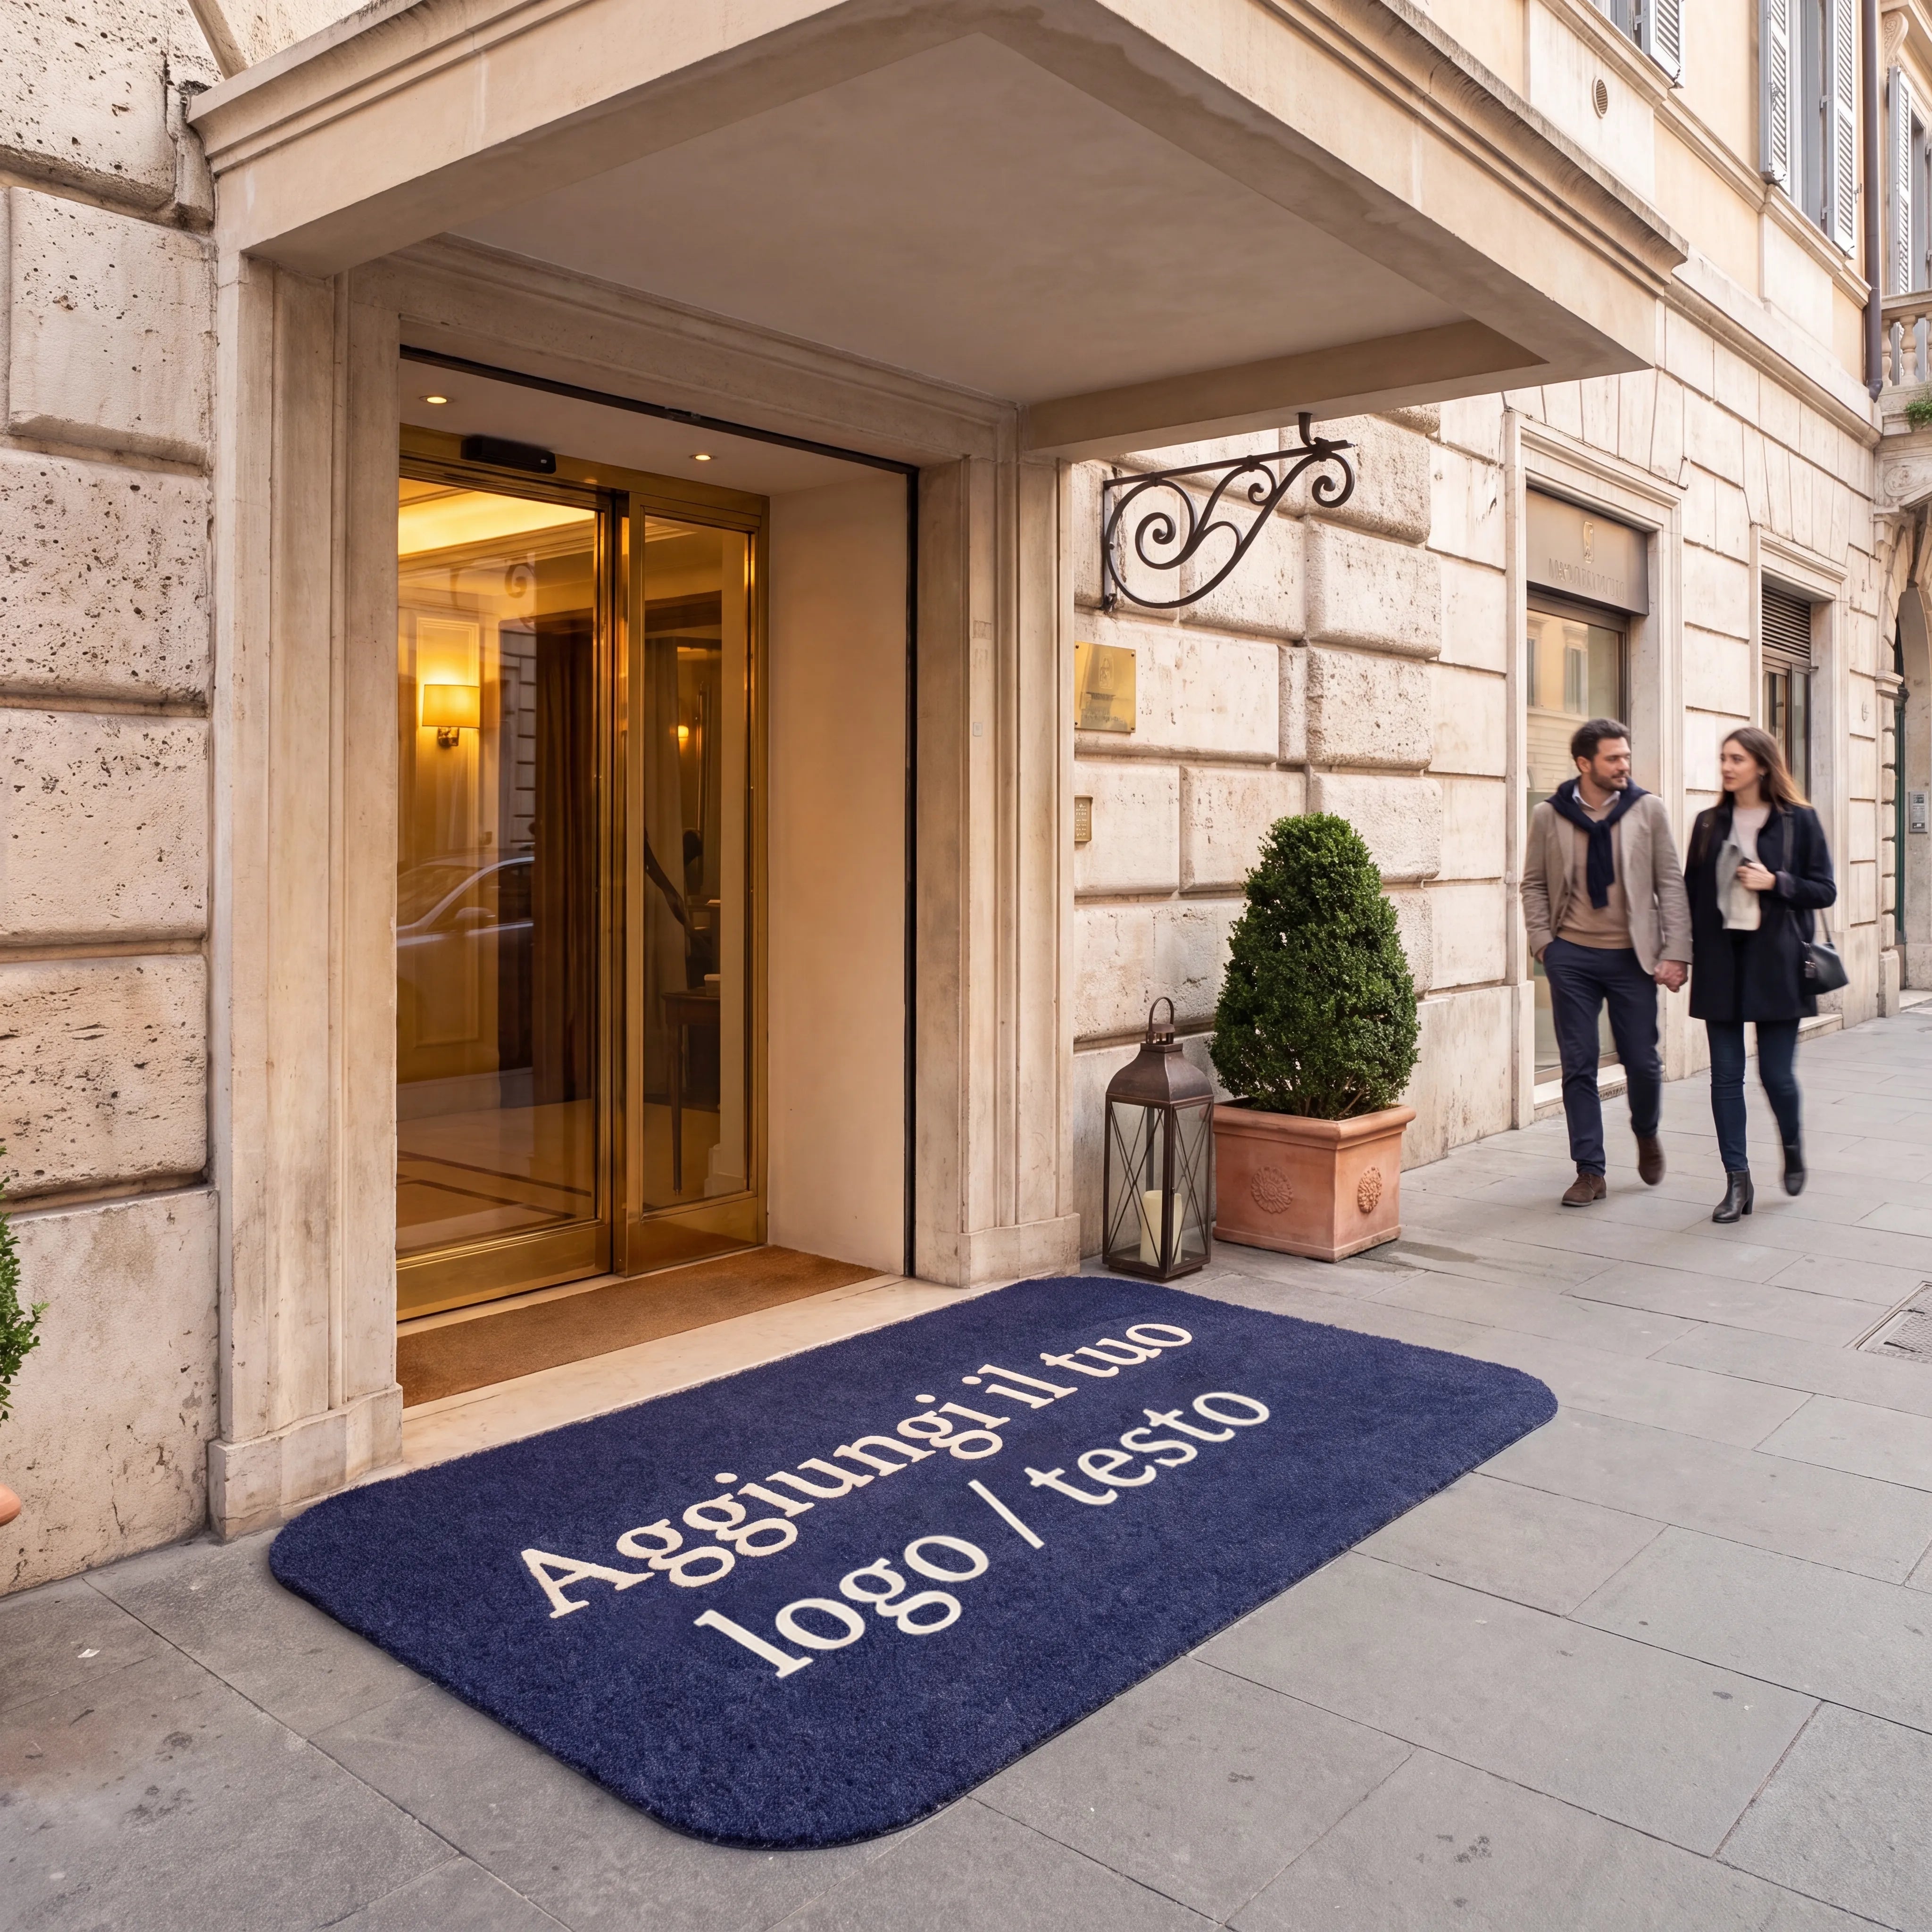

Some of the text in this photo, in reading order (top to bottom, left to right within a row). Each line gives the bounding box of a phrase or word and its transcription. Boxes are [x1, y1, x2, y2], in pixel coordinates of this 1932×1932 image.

[520, 1323, 1192, 1619] Aggiungi il tuo
[693, 1391, 1270, 1679] logo / testo
